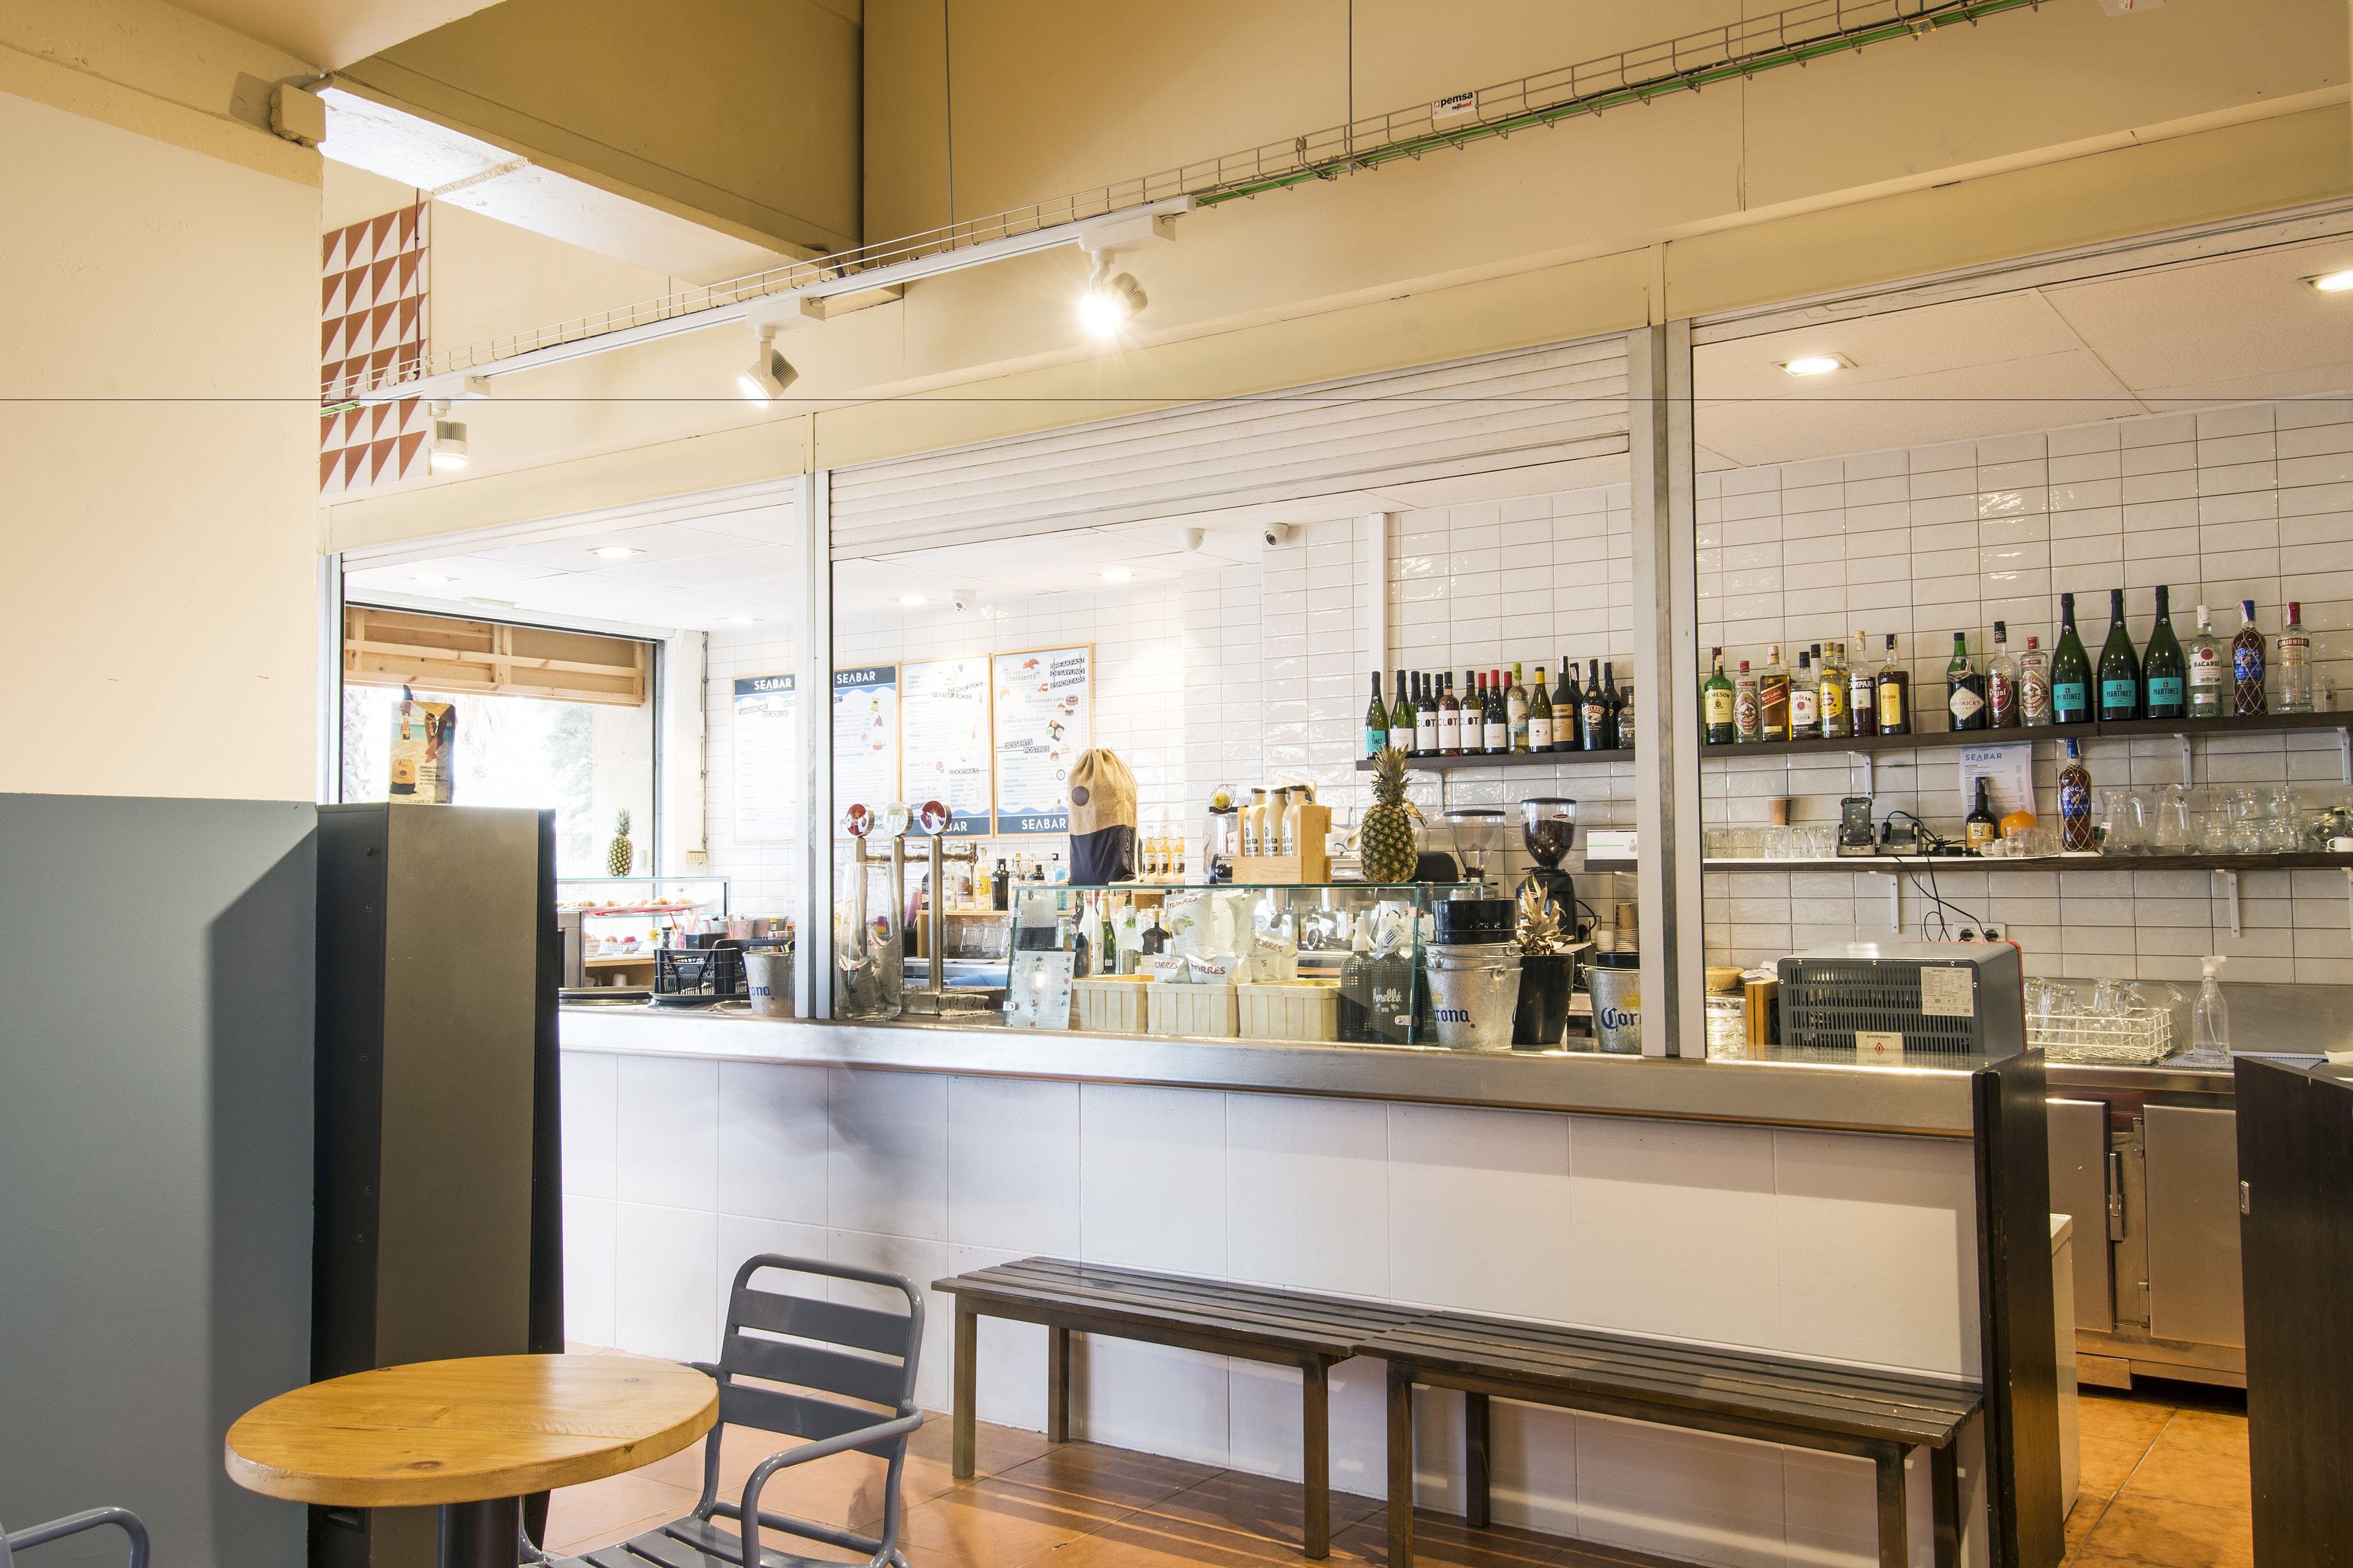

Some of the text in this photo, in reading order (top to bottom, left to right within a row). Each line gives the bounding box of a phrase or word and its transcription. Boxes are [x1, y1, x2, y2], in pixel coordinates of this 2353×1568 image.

[1441, 92, 1473, 107] pemsa
[1452, 100, 1472, 110] rejiband
[1050, 657, 1085, 669] BREAKFAST
[837, 671, 876, 684] SEABAR
[1051, 677, 1085, 688] ESMORZARS
[754, 678, 792, 691] SEABAR
[1848, 680, 1873, 689] CAMPARI
[1770, 690, 1781, 699] Label
[1798, 694, 1811, 703] BEAM
[1989, 688, 2006, 698] Pujol
[2056, 693, 2080, 702] MARTINEZ
[740, 704, 768, 715] SANDWICHES
[1004, 739, 1033, 749] DESSERTS
[1965, 752, 2003, 762] SEABAR
[947, 821, 968, 831] BAR
[1021, 818, 1066, 830] SEABAR
[1169, 896, 1198, 909] TORRES
[1256, 938, 1283, 953] TORRES
[1191, 963, 1226, 975] TORRES
[749, 985, 771, 996] ona
[1433, 1009, 1471, 1023] rona
[1601, 1007, 1640, 1032] Cor
